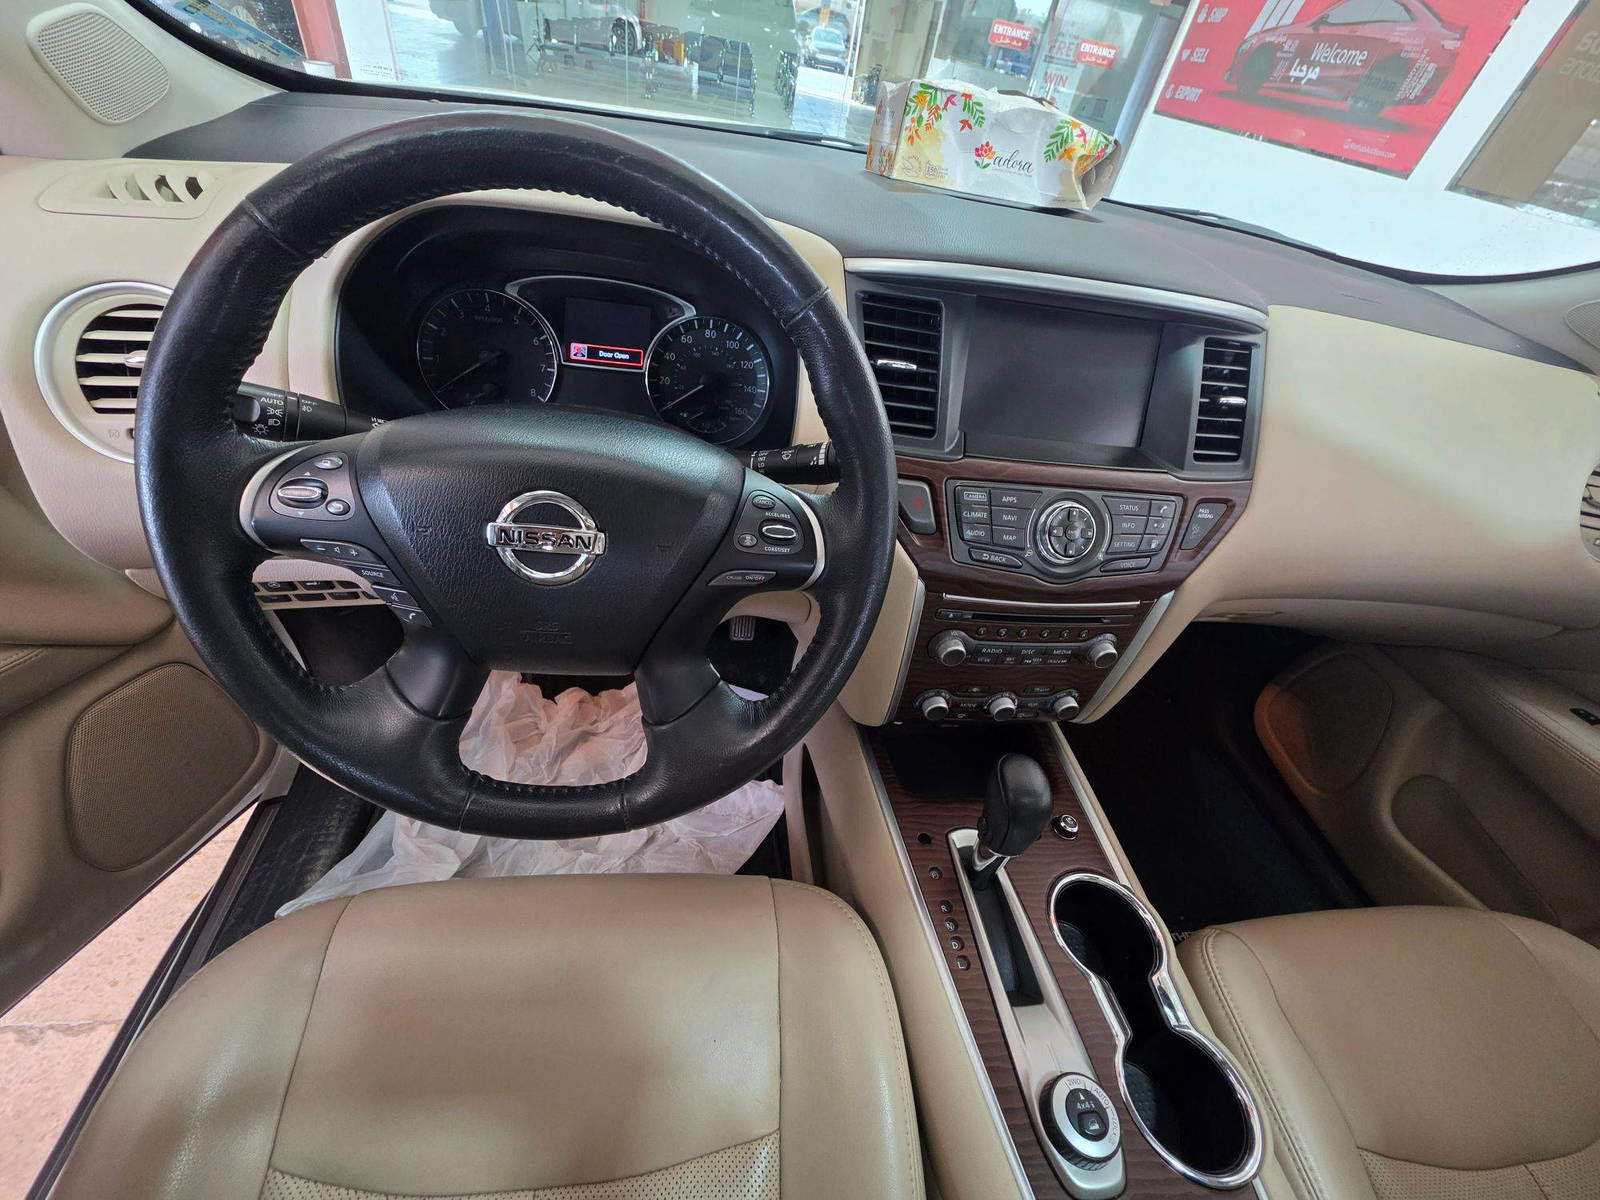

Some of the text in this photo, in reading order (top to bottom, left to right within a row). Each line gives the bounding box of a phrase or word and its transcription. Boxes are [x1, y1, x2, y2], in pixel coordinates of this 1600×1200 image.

[993, 23, 1031, 40] ENTRANCE
[1080, 42, 1117, 58] ENTRANCE
[1310, 42, 1368, 66] Welcome
[1190, 47, 1210, 63] SELL
[1288, 57, 1321, 85] مرحبا
[993, 149, 1034, 174] adora
[513, 315, 520, 325] 5
[704, 329, 717, 338] 80
[533, 336, 540, 346] 6
[681, 335, 693, 344] 60
[726, 341, 740, 350] 100
[598, 350, 630, 360] Door Open
[664, 352, 676, 361] 40
[539, 363, 546, 373] 7
[740, 360, 754, 369] 120
[659, 376, 671, 385] 20
[530, 388, 536, 397] 8
[744, 385, 757, 394] 140
[260, 397, 284, 406] AUTO
[734, 407, 747, 416] 160
[965, 492, 986, 500] CAMERA
[1119, 504, 1139, 512] STATUS
[962, 511, 988, 519] CLIMATE
[965, 529, 985, 537] AUDIO
[499, 528, 592, 550] NISSAN
[361, 569, 384, 578] SOURCE
[951, 941, 958, 950] D
[957, 960, 967, 969] L
